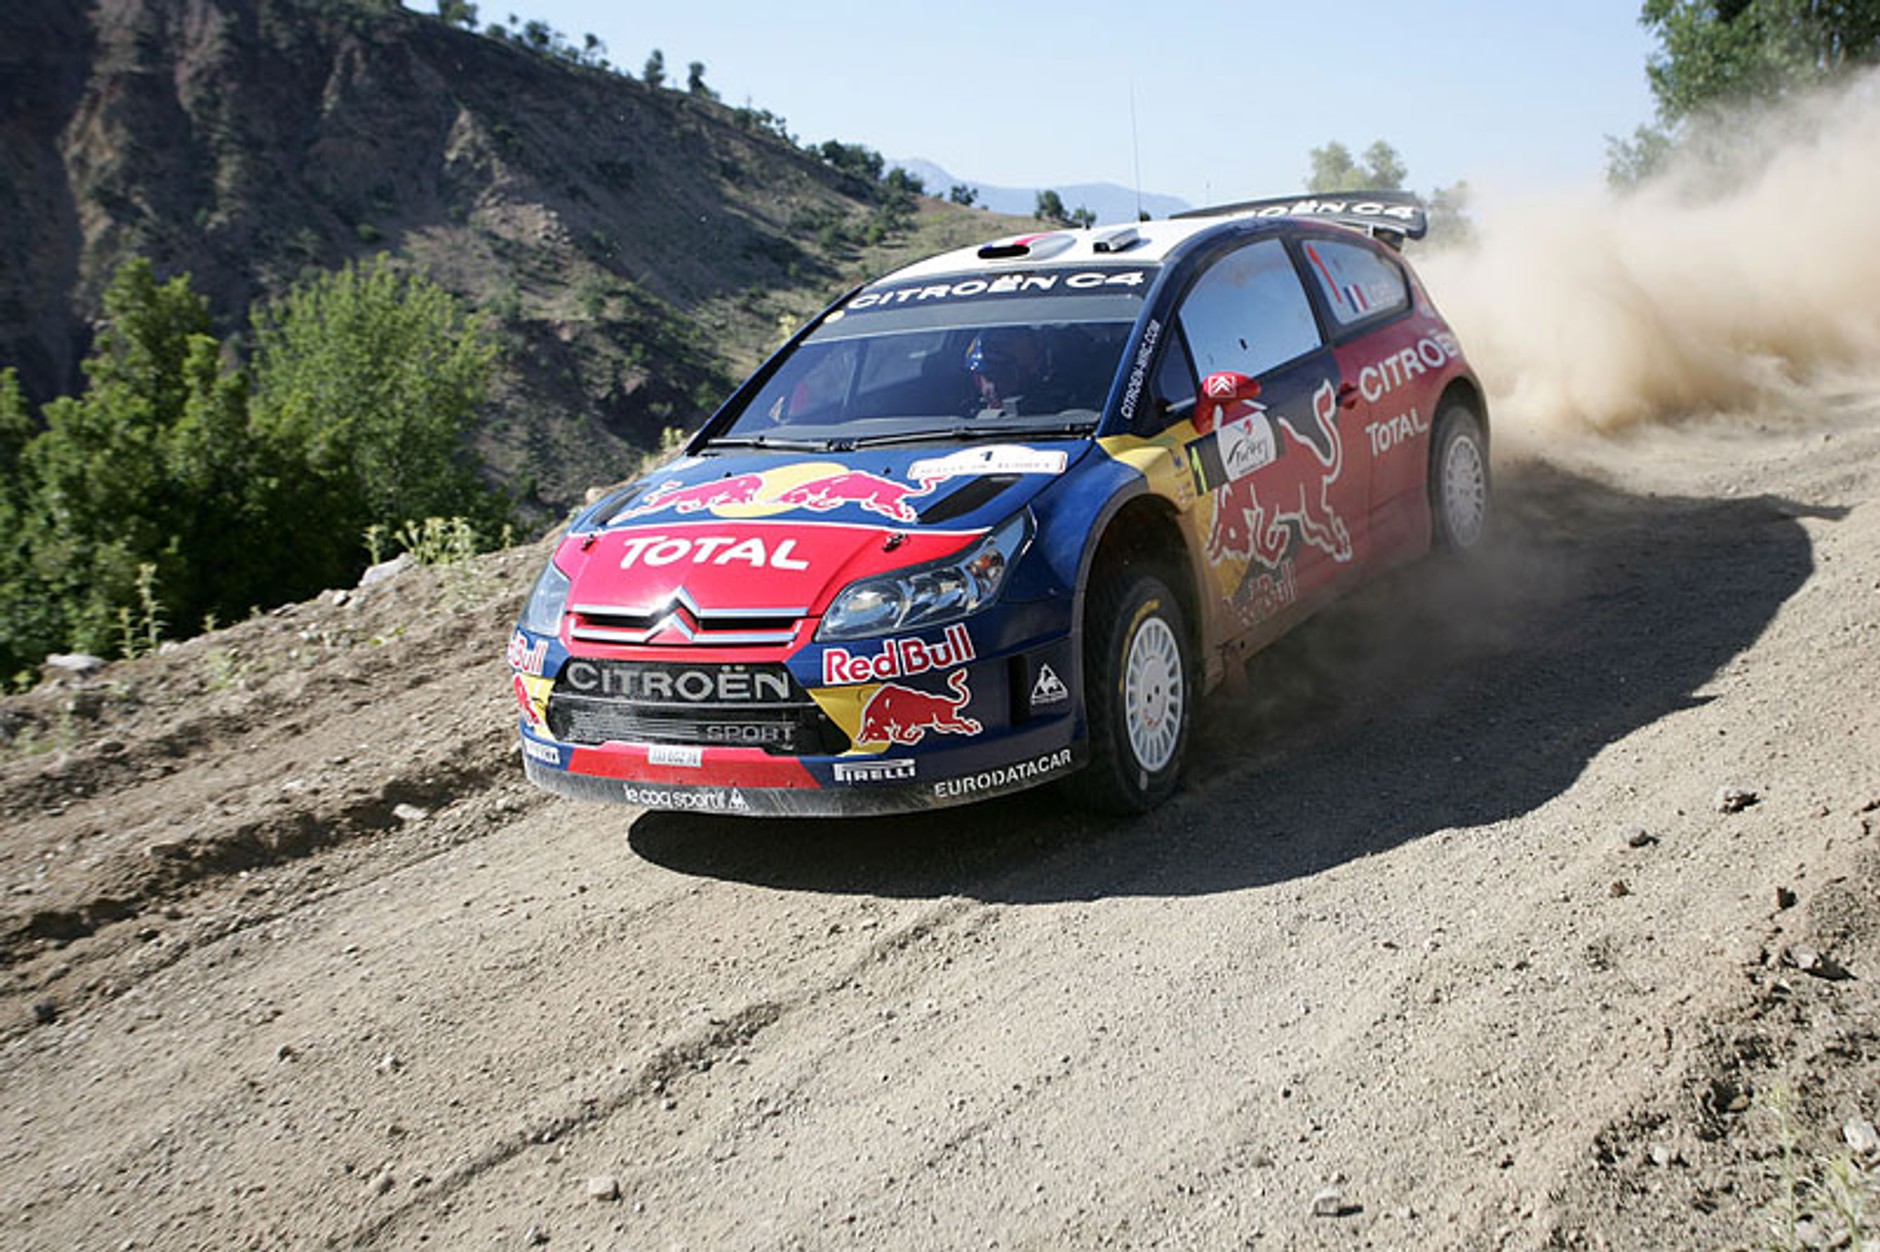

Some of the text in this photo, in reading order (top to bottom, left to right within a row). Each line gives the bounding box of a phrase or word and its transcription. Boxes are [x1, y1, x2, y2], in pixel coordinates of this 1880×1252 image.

[847, 271, 1145, 310] CITROËN C4
[1365, 407, 1429, 458] TOTAL
[980, 450, 994, 462] 1
[619, 535, 810, 570] TOTAL
[823, 622, 977, 686] Red Bull
[566, 662, 790, 700] CITROËN
[706, 724, 796, 742] SPORT
[832, 758, 917, 783] PIRELLI
[934, 748, 1073, 799] EURODATACAR
[639, 788, 673, 810] coq
